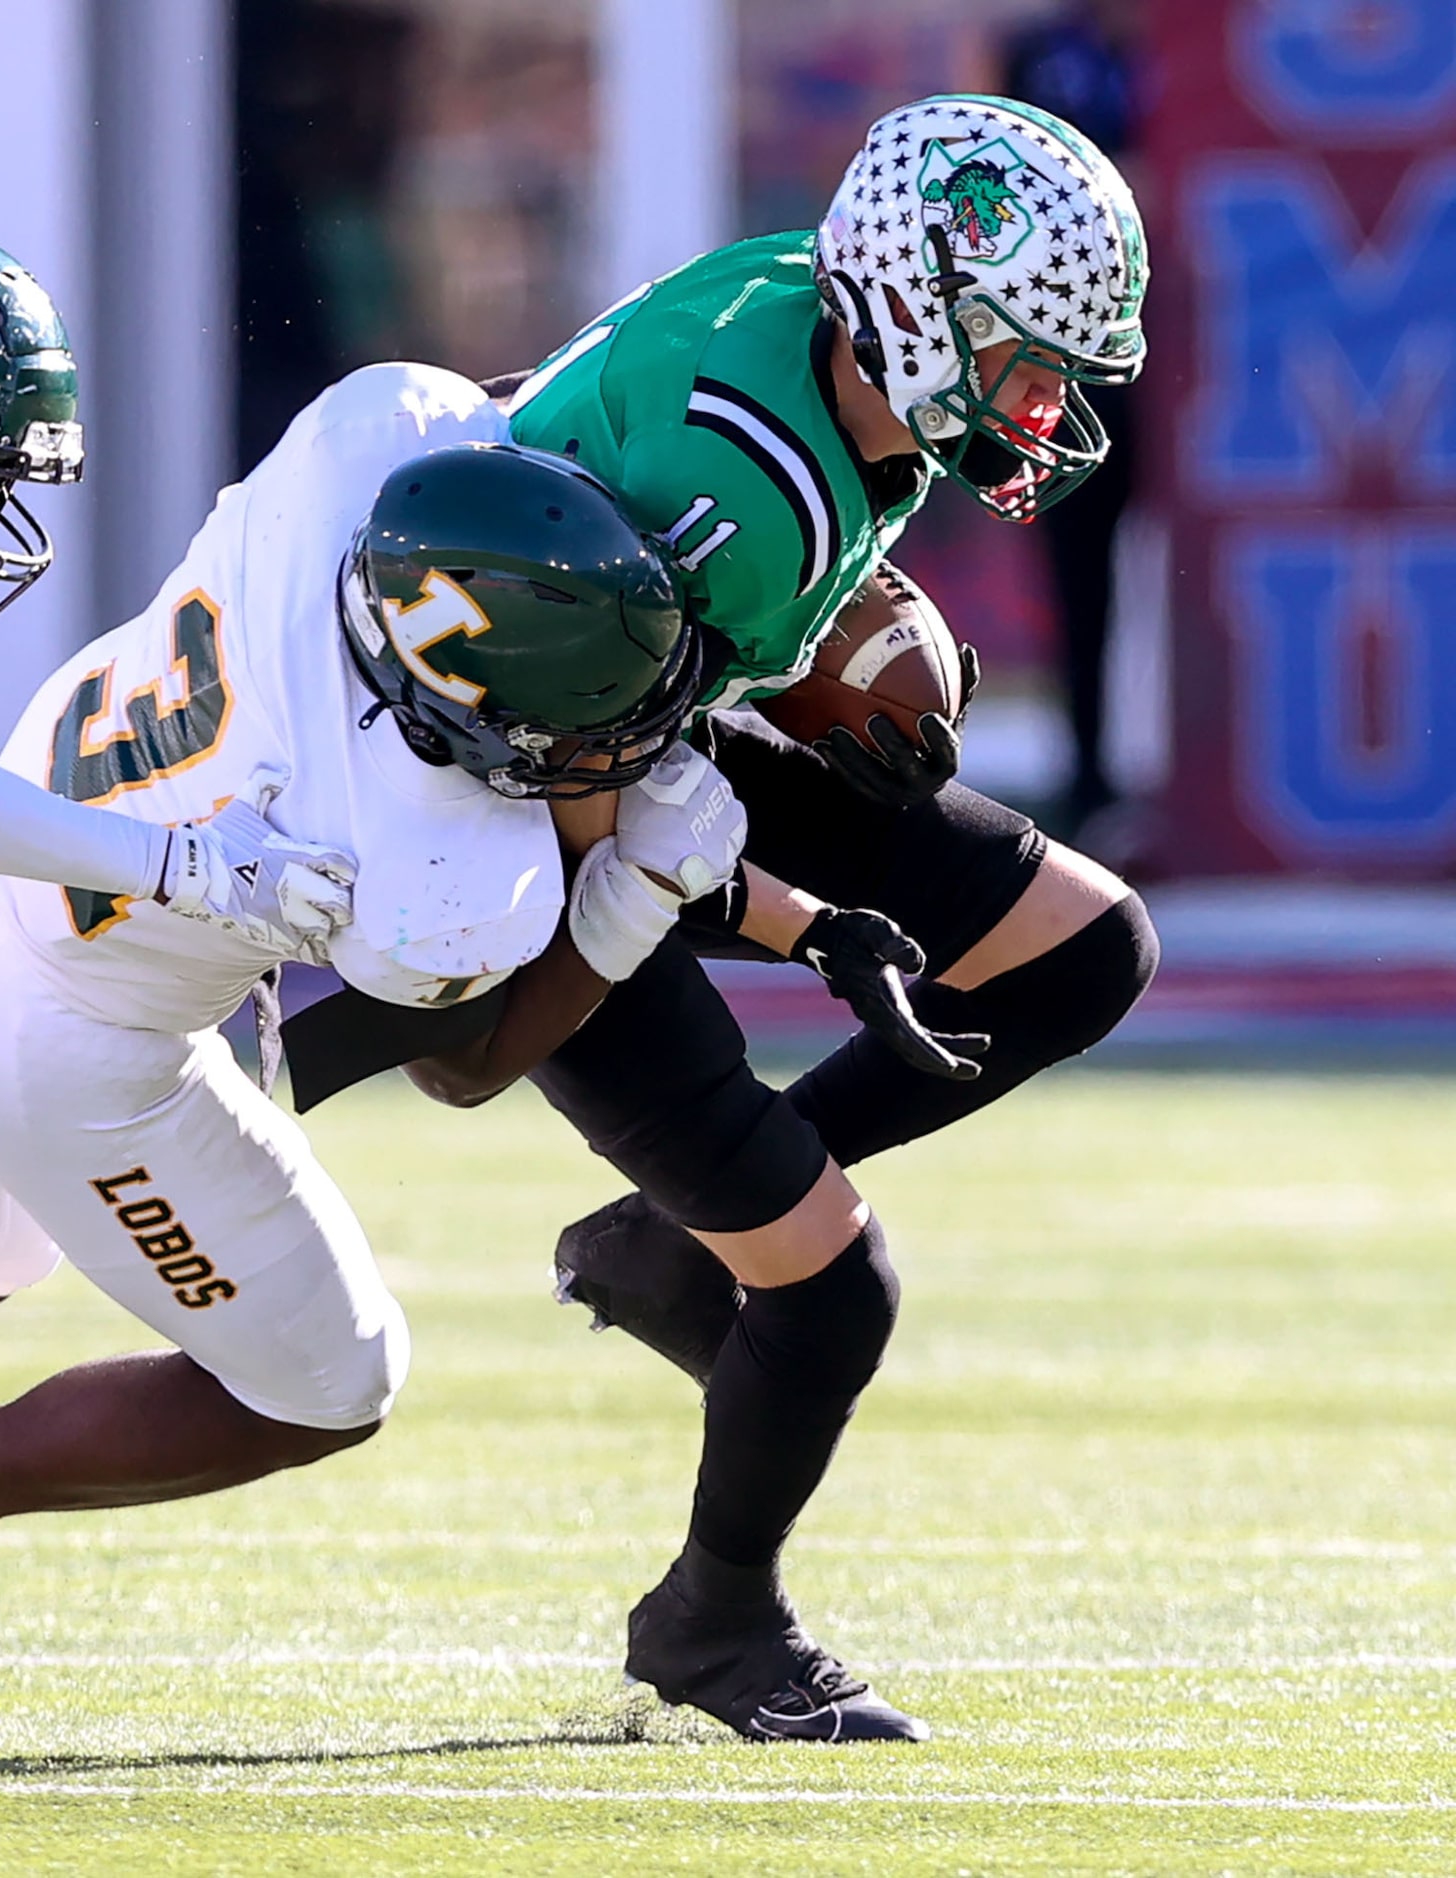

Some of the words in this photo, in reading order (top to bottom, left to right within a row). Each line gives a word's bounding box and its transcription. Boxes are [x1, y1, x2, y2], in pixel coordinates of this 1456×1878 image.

[652, 494, 741, 573] 11
[382, 568, 492, 708] L
[87, 1165, 239, 1312] LOBOS
